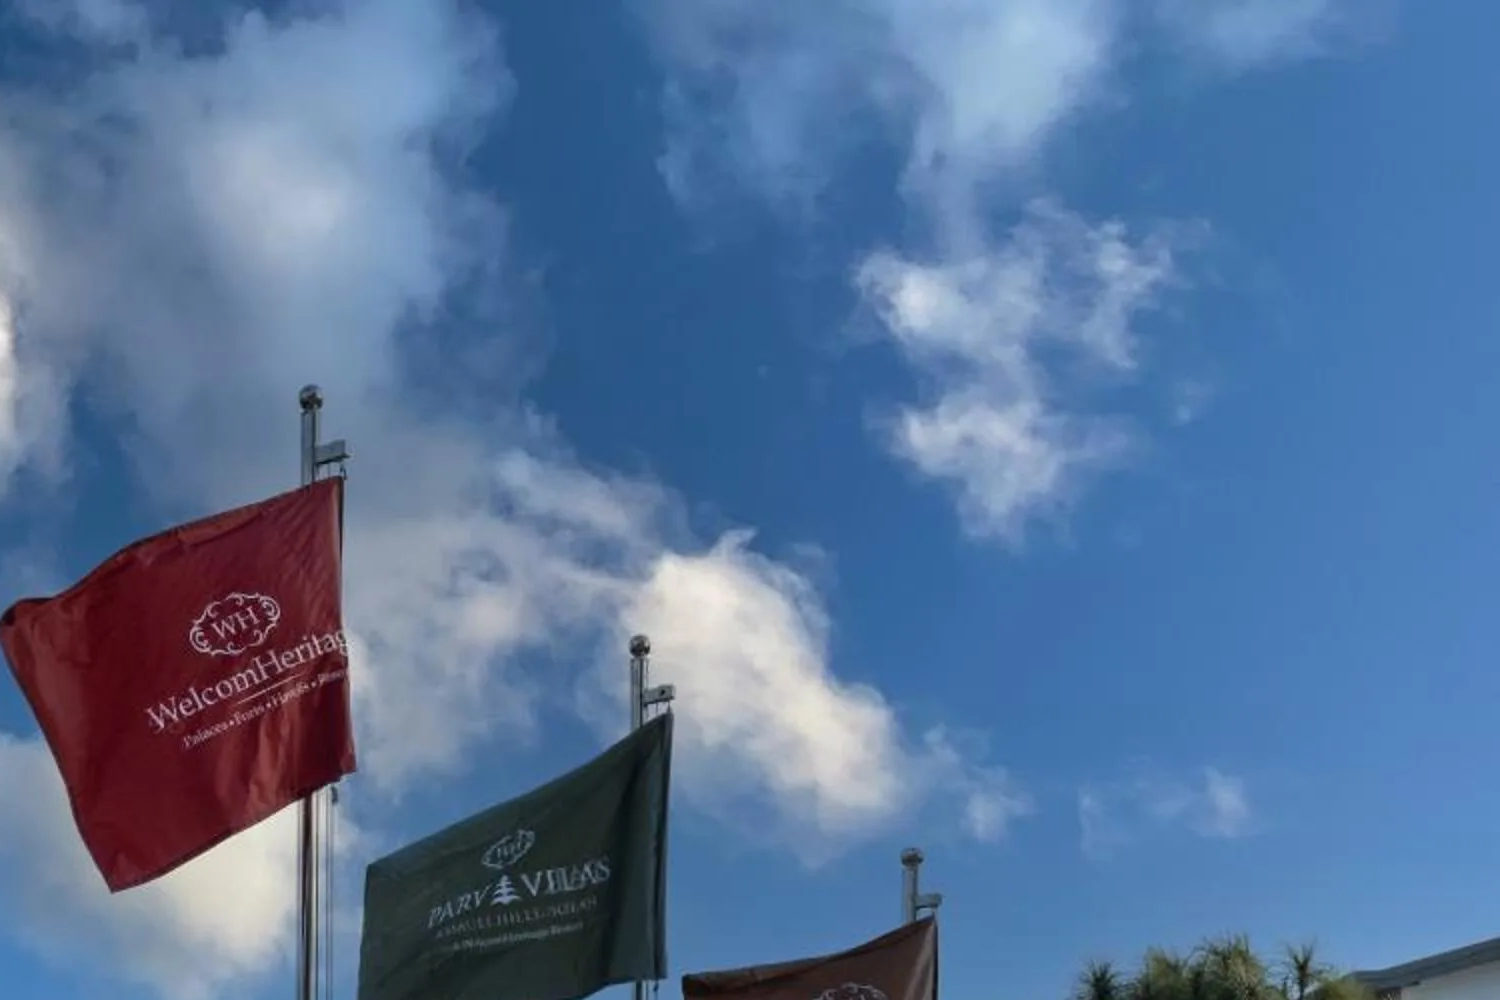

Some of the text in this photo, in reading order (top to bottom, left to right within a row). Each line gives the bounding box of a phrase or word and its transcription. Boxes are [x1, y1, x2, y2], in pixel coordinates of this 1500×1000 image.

[211, 606, 261, 639] WH
[145, 629, 350, 731] WelcomHeritag
[427, 857, 612, 929] PARV VILAS
